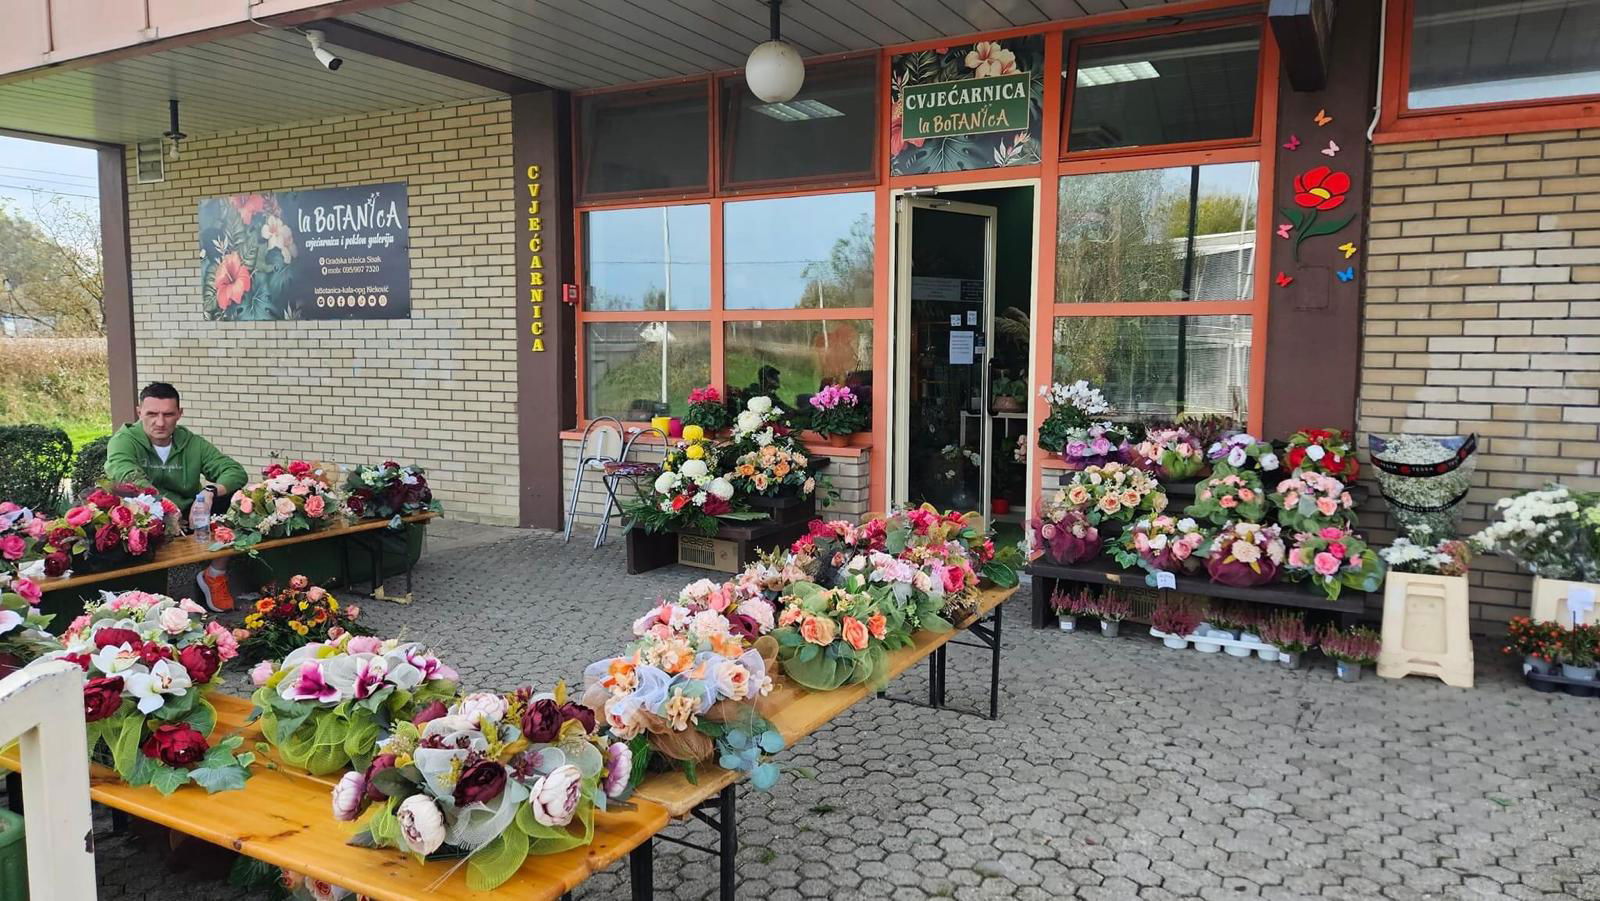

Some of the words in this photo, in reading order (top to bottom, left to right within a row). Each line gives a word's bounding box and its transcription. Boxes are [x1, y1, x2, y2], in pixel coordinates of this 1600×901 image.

[905, 82, 1026, 110] CVJEĆARNICA
[918, 117, 930, 134] la
[298, 208, 311, 233] la
[344, 234, 367, 250] poklon
[367, 233, 395, 248] galerija
[527, 165, 545, 352] CVJEĆARNICA
